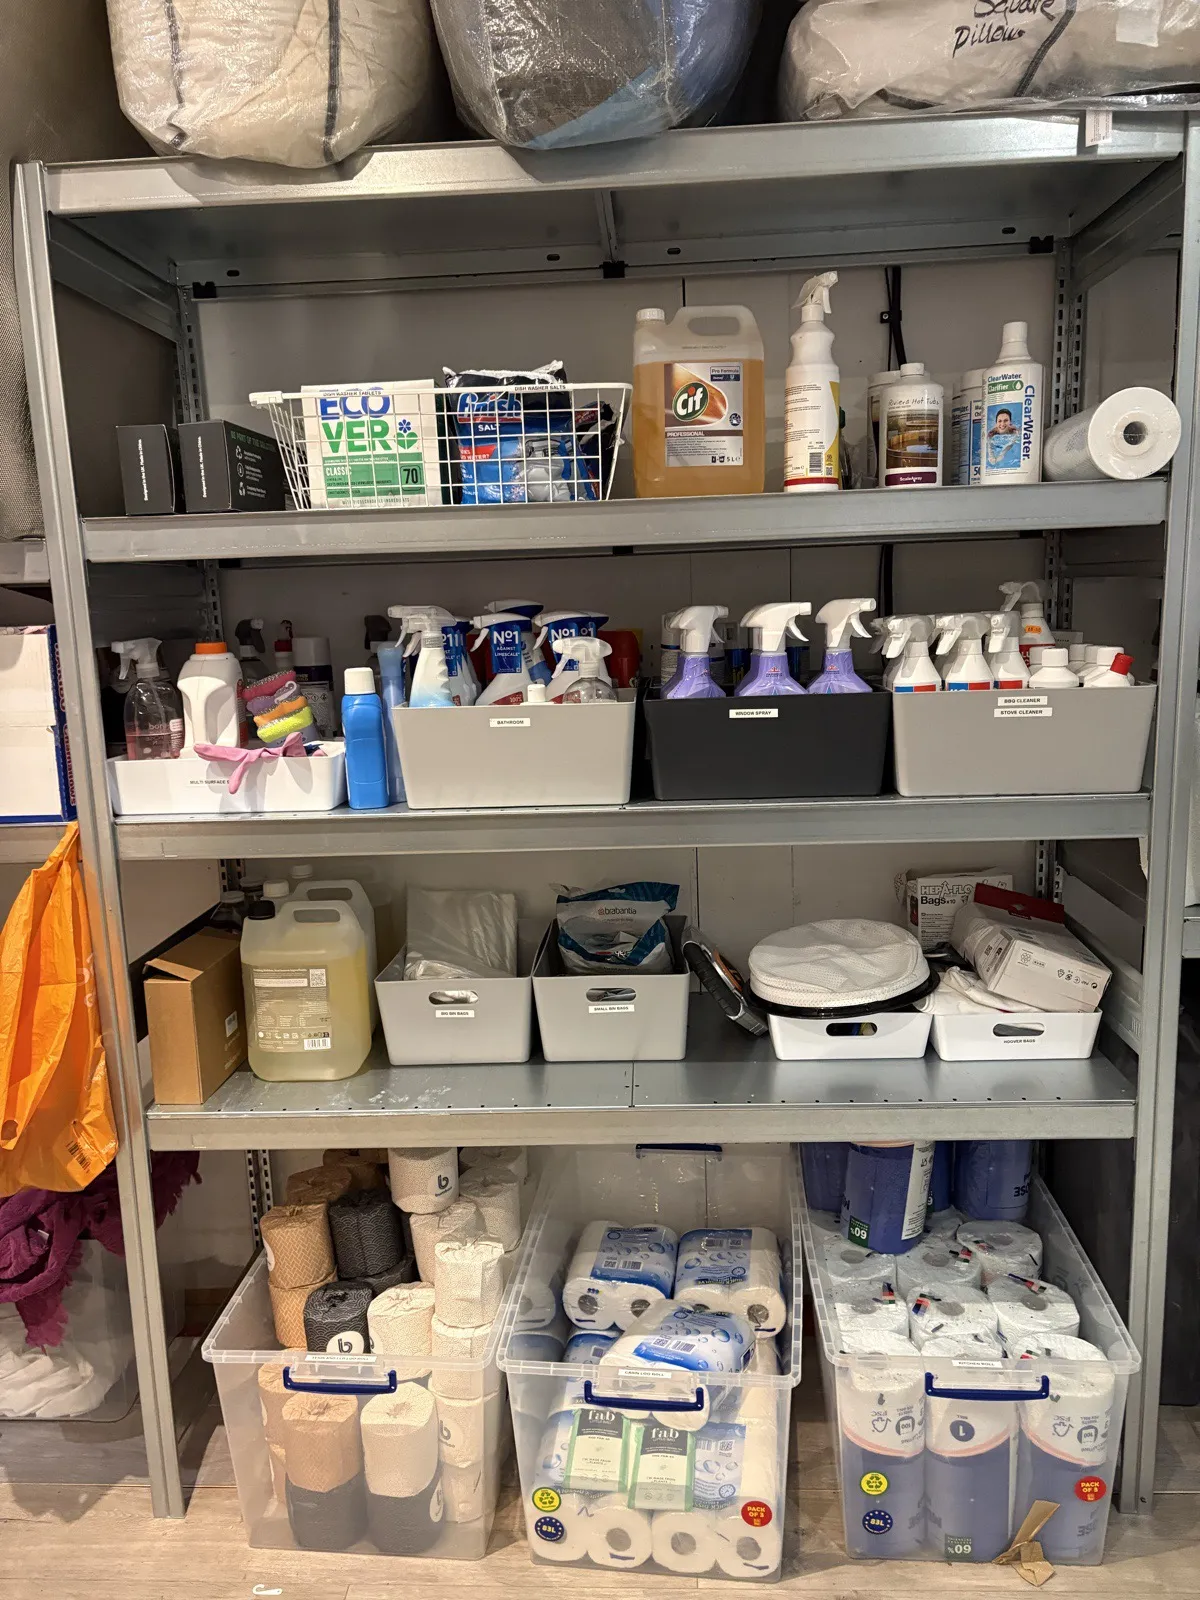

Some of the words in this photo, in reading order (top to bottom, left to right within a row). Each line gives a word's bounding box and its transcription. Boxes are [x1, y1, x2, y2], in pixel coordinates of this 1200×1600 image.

[319, 387, 391, 421] ECO
[676, 386, 703, 416] Cif
[321, 419, 393, 453] VER
[402, 468, 419, 485] 70
[920, 896, 946, 907] Bags
[604, 907, 637, 915] brabantia
[588, 1410, 616, 1422] fab
[651, 1428, 680, 1439] fab
[870, 1518, 885, 1526] 83L
[542, 1524, 556, 1534] 83L
